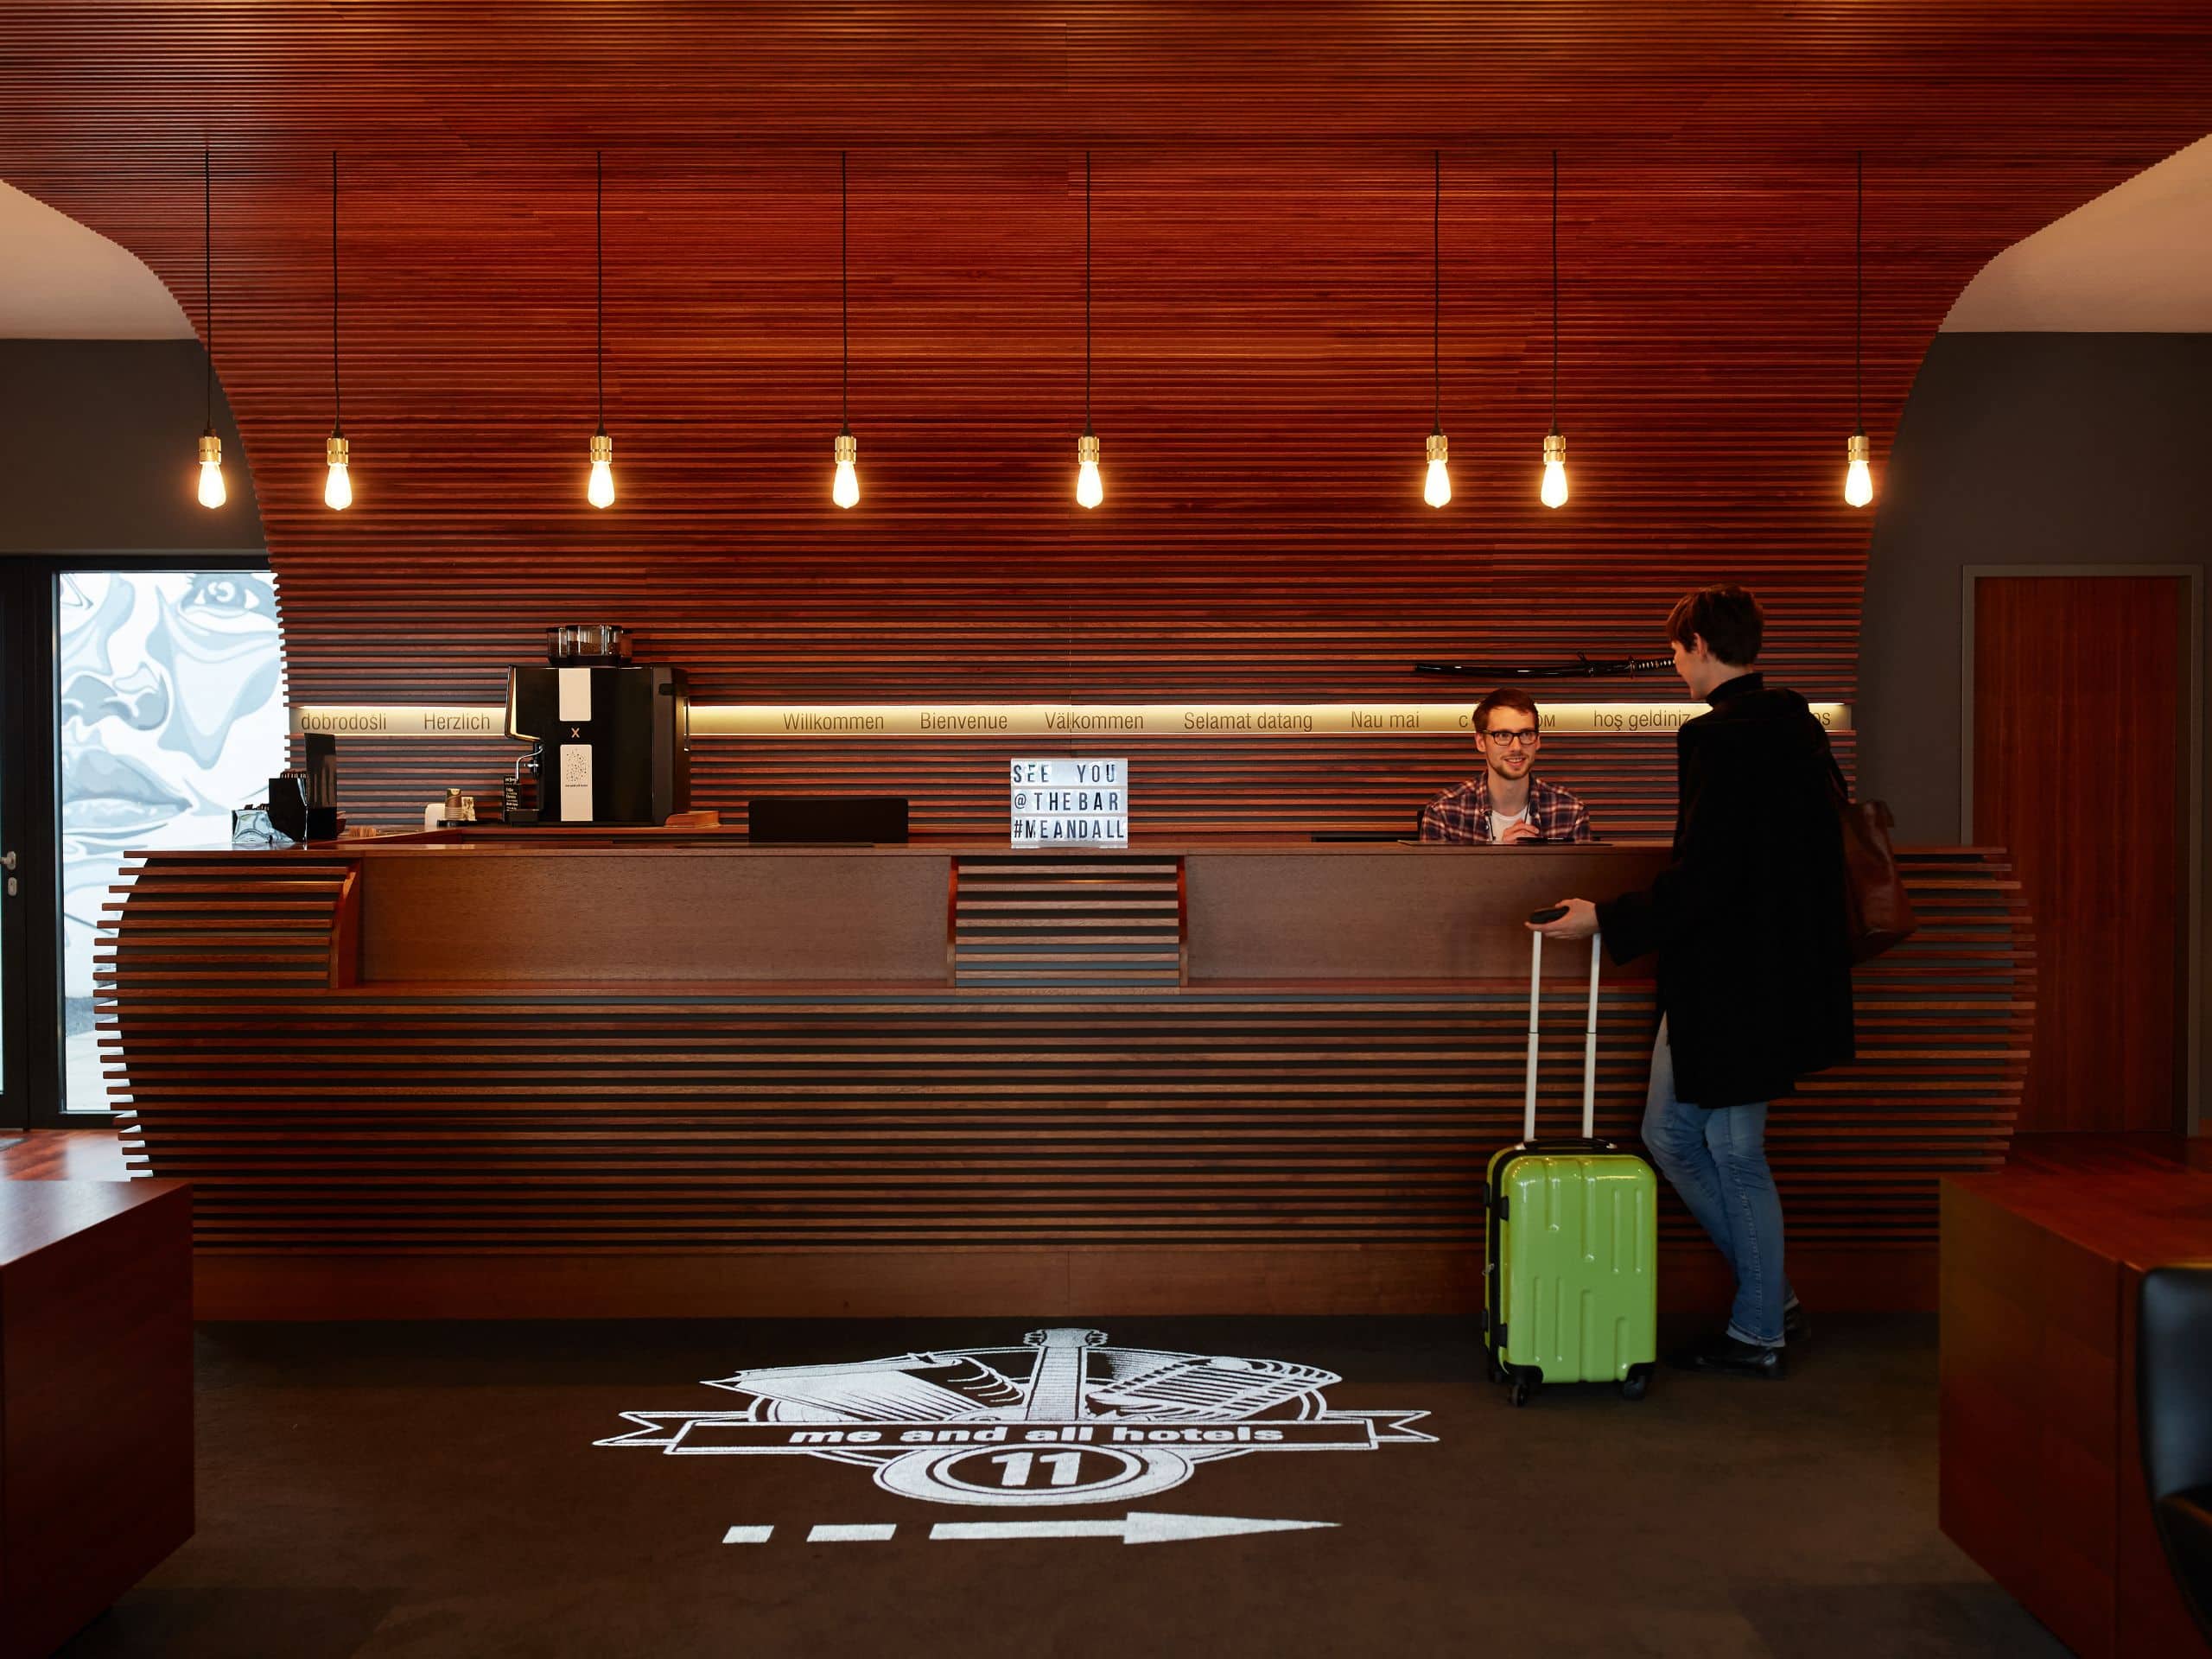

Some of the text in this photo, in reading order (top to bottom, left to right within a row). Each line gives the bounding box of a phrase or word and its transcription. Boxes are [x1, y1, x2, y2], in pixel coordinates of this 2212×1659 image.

[423, 712, 491, 730] Herzlich
[783, 712, 884, 730] Willkommen
[920, 711, 1008, 729] Bienvenue
[1044, 711, 1144, 729] Välkommen
[1184, 711, 1313, 732] Selamat datang
[1351, 710, 1420, 728] Nau mai
[1013, 764, 1116, 784] SEE YOU
[1014, 819, 1124, 839] #MEANDALL
[788, 1426, 1284, 1443] me and all hotels
[990, 1452, 1083, 1487] 11
